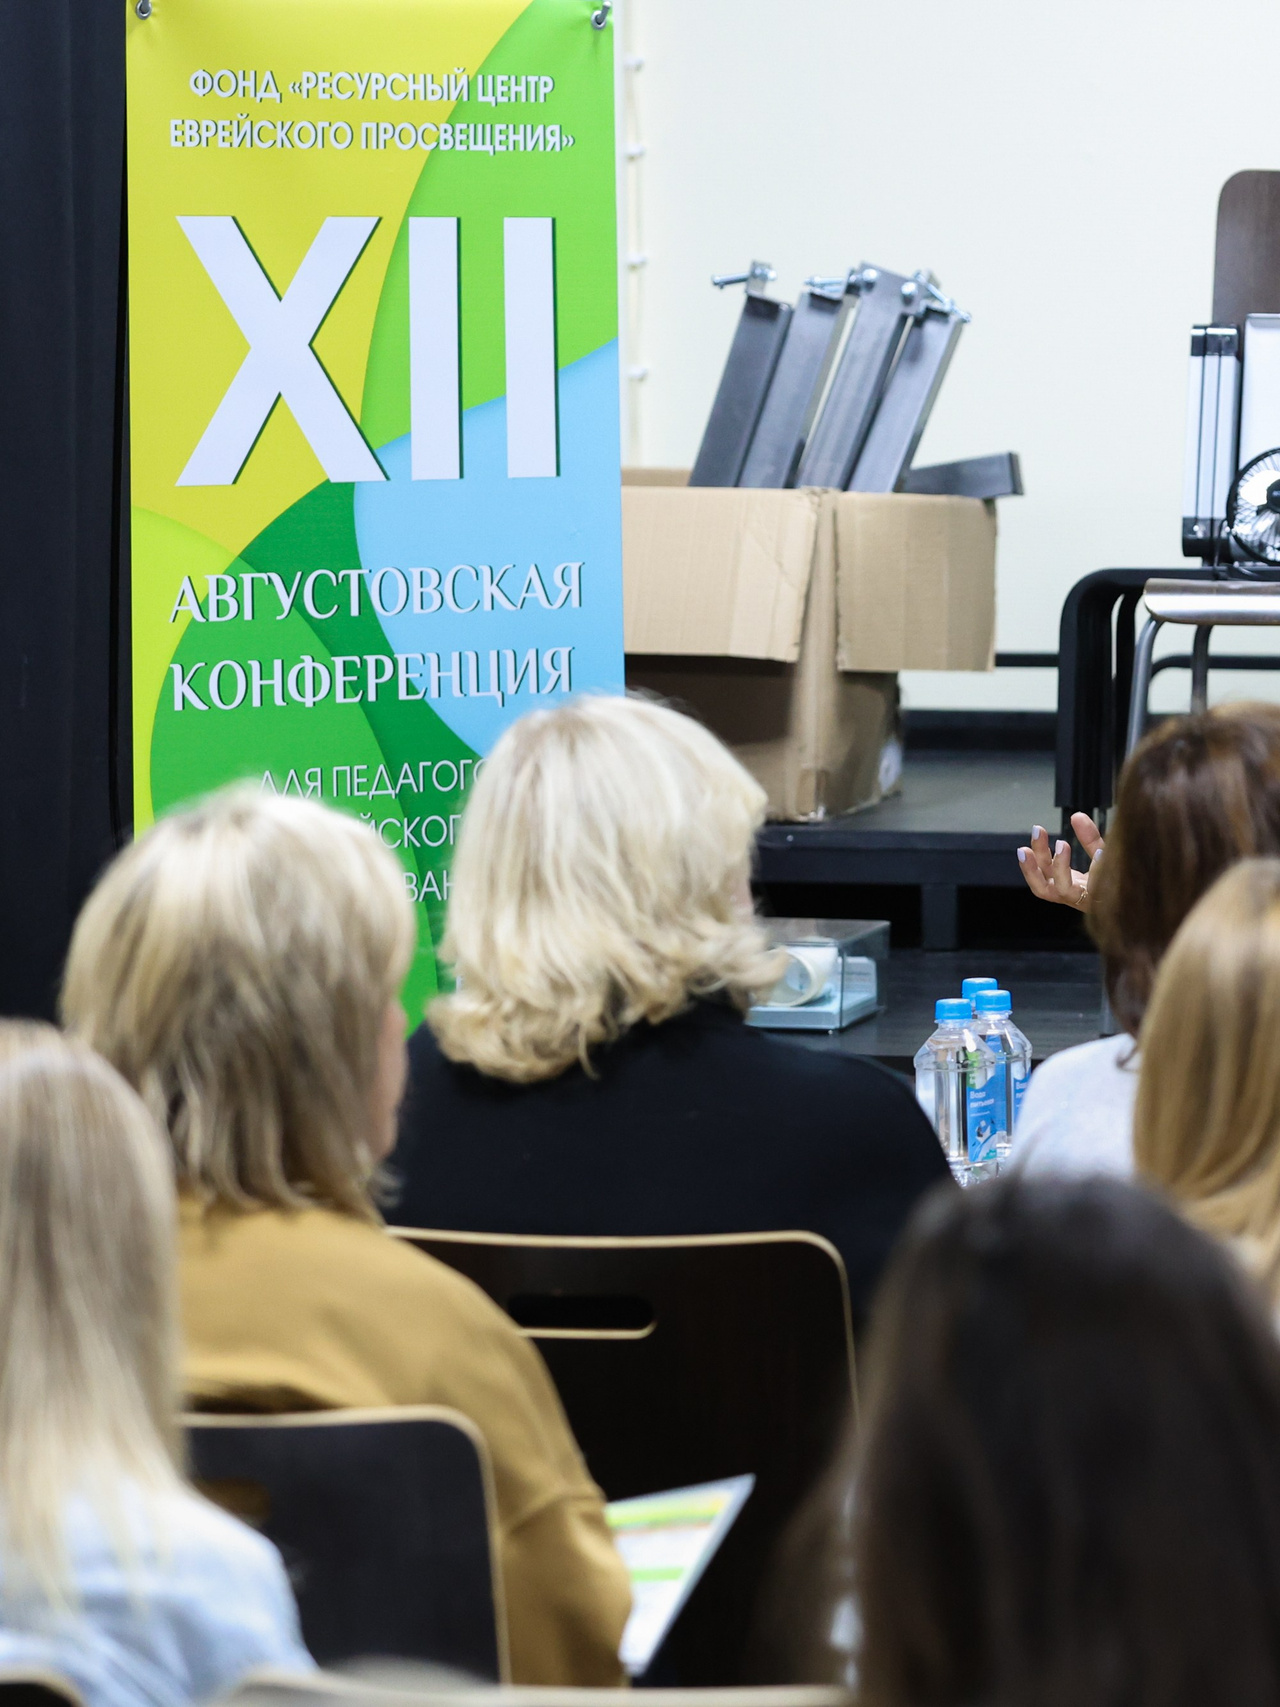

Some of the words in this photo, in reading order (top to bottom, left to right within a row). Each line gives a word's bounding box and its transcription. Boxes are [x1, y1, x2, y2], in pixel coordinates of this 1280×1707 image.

[189, 69, 282, 102] ФОНД
[288, 67, 470, 102] «РЕСУРСНЫЙ
[477, 75, 555, 107] ЦЕНТР
[169, 113, 354, 150] ЕВРЕЙСКОГО
[361, 120, 575, 155] ПРОСВЕЩЕНИЯ»
[174, 215, 561, 487] XII
[168, 561, 584, 623] АВГУСТОВСКАЯ
[169, 646, 575, 711] КОНФЕРЕНЦИЯ
